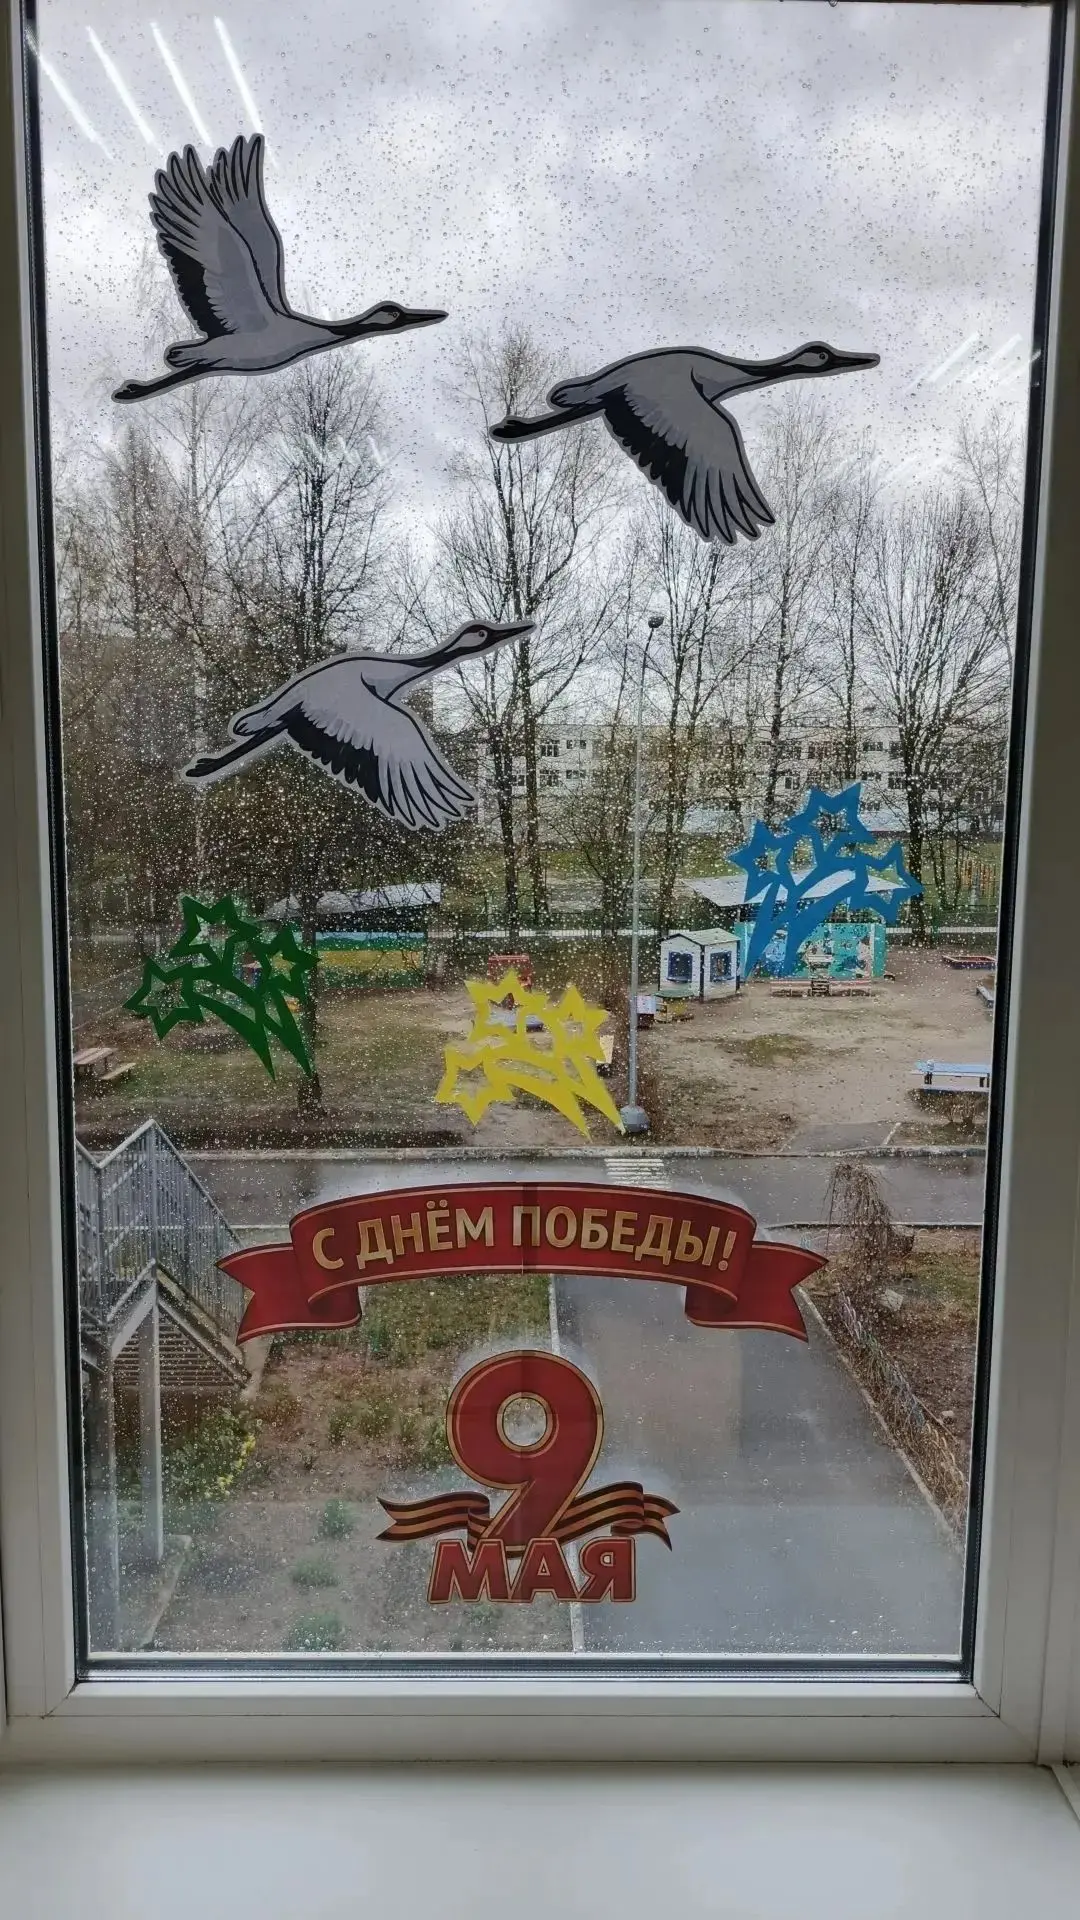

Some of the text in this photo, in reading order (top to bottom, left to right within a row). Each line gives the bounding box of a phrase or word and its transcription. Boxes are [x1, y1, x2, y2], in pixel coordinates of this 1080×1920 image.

[311, 1199, 738, 1272] С ДНЁМ ПОБЕДЫ!
[446, 1350, 604, 1549] 9
[427, 1536, 636, 1604] МАЯ
